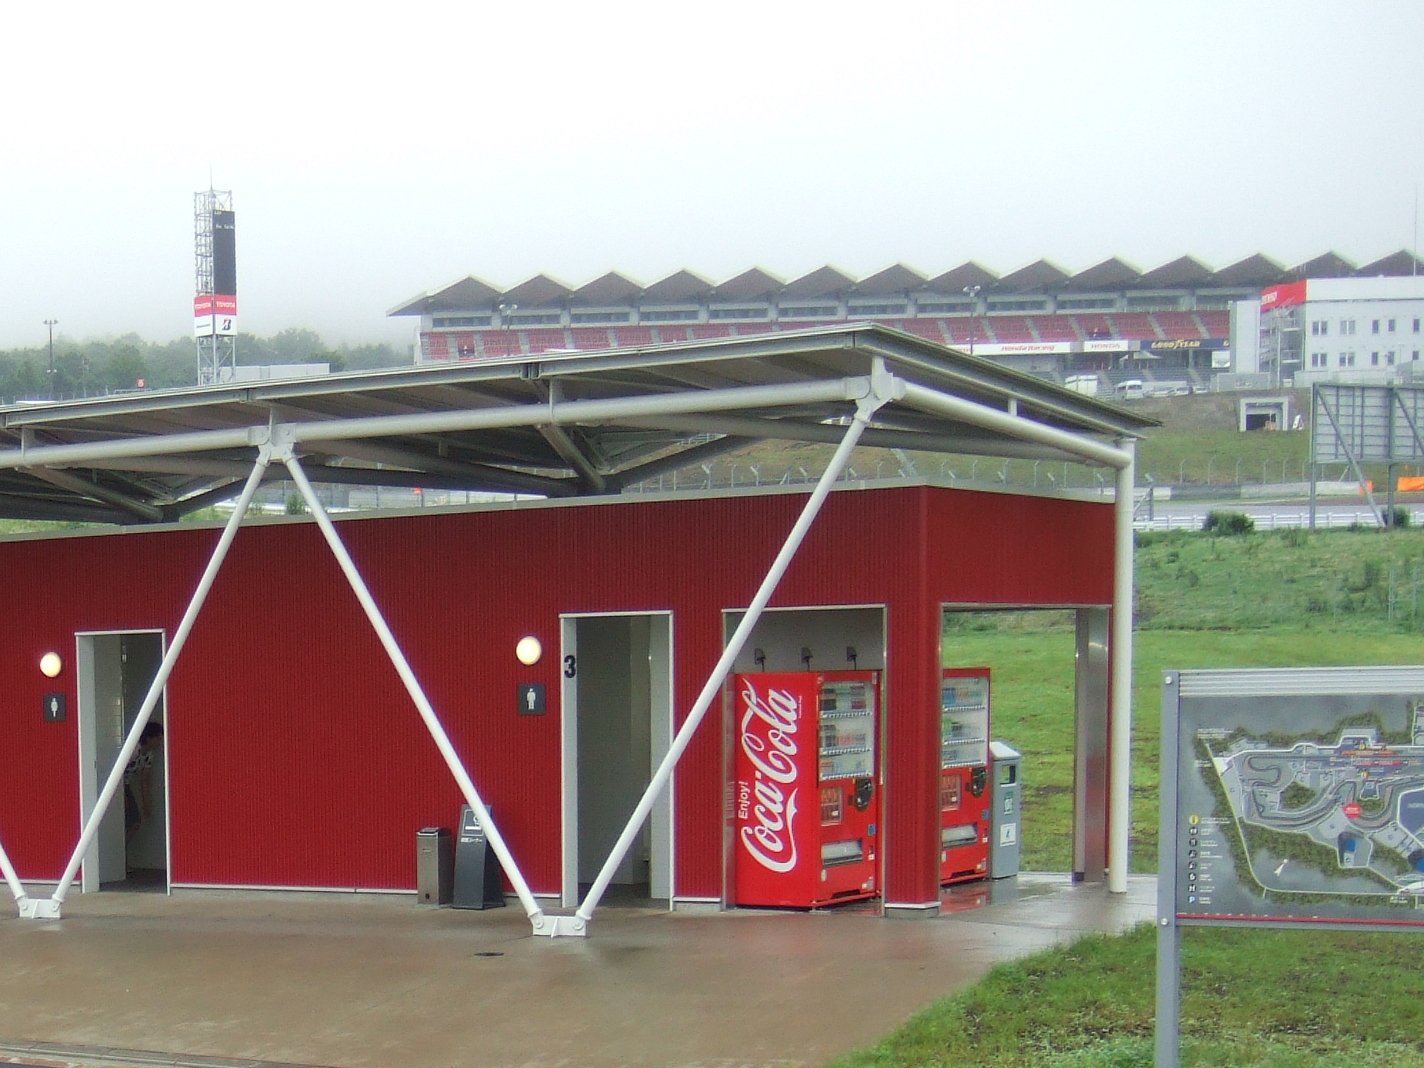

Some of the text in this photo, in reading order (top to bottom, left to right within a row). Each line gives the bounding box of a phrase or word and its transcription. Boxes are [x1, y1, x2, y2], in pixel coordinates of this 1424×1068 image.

[564, 655, 576, 678] 3
[741, 678, 798, 873] Coca-Cola
[738, 781, 750, 820] Enjoy!
